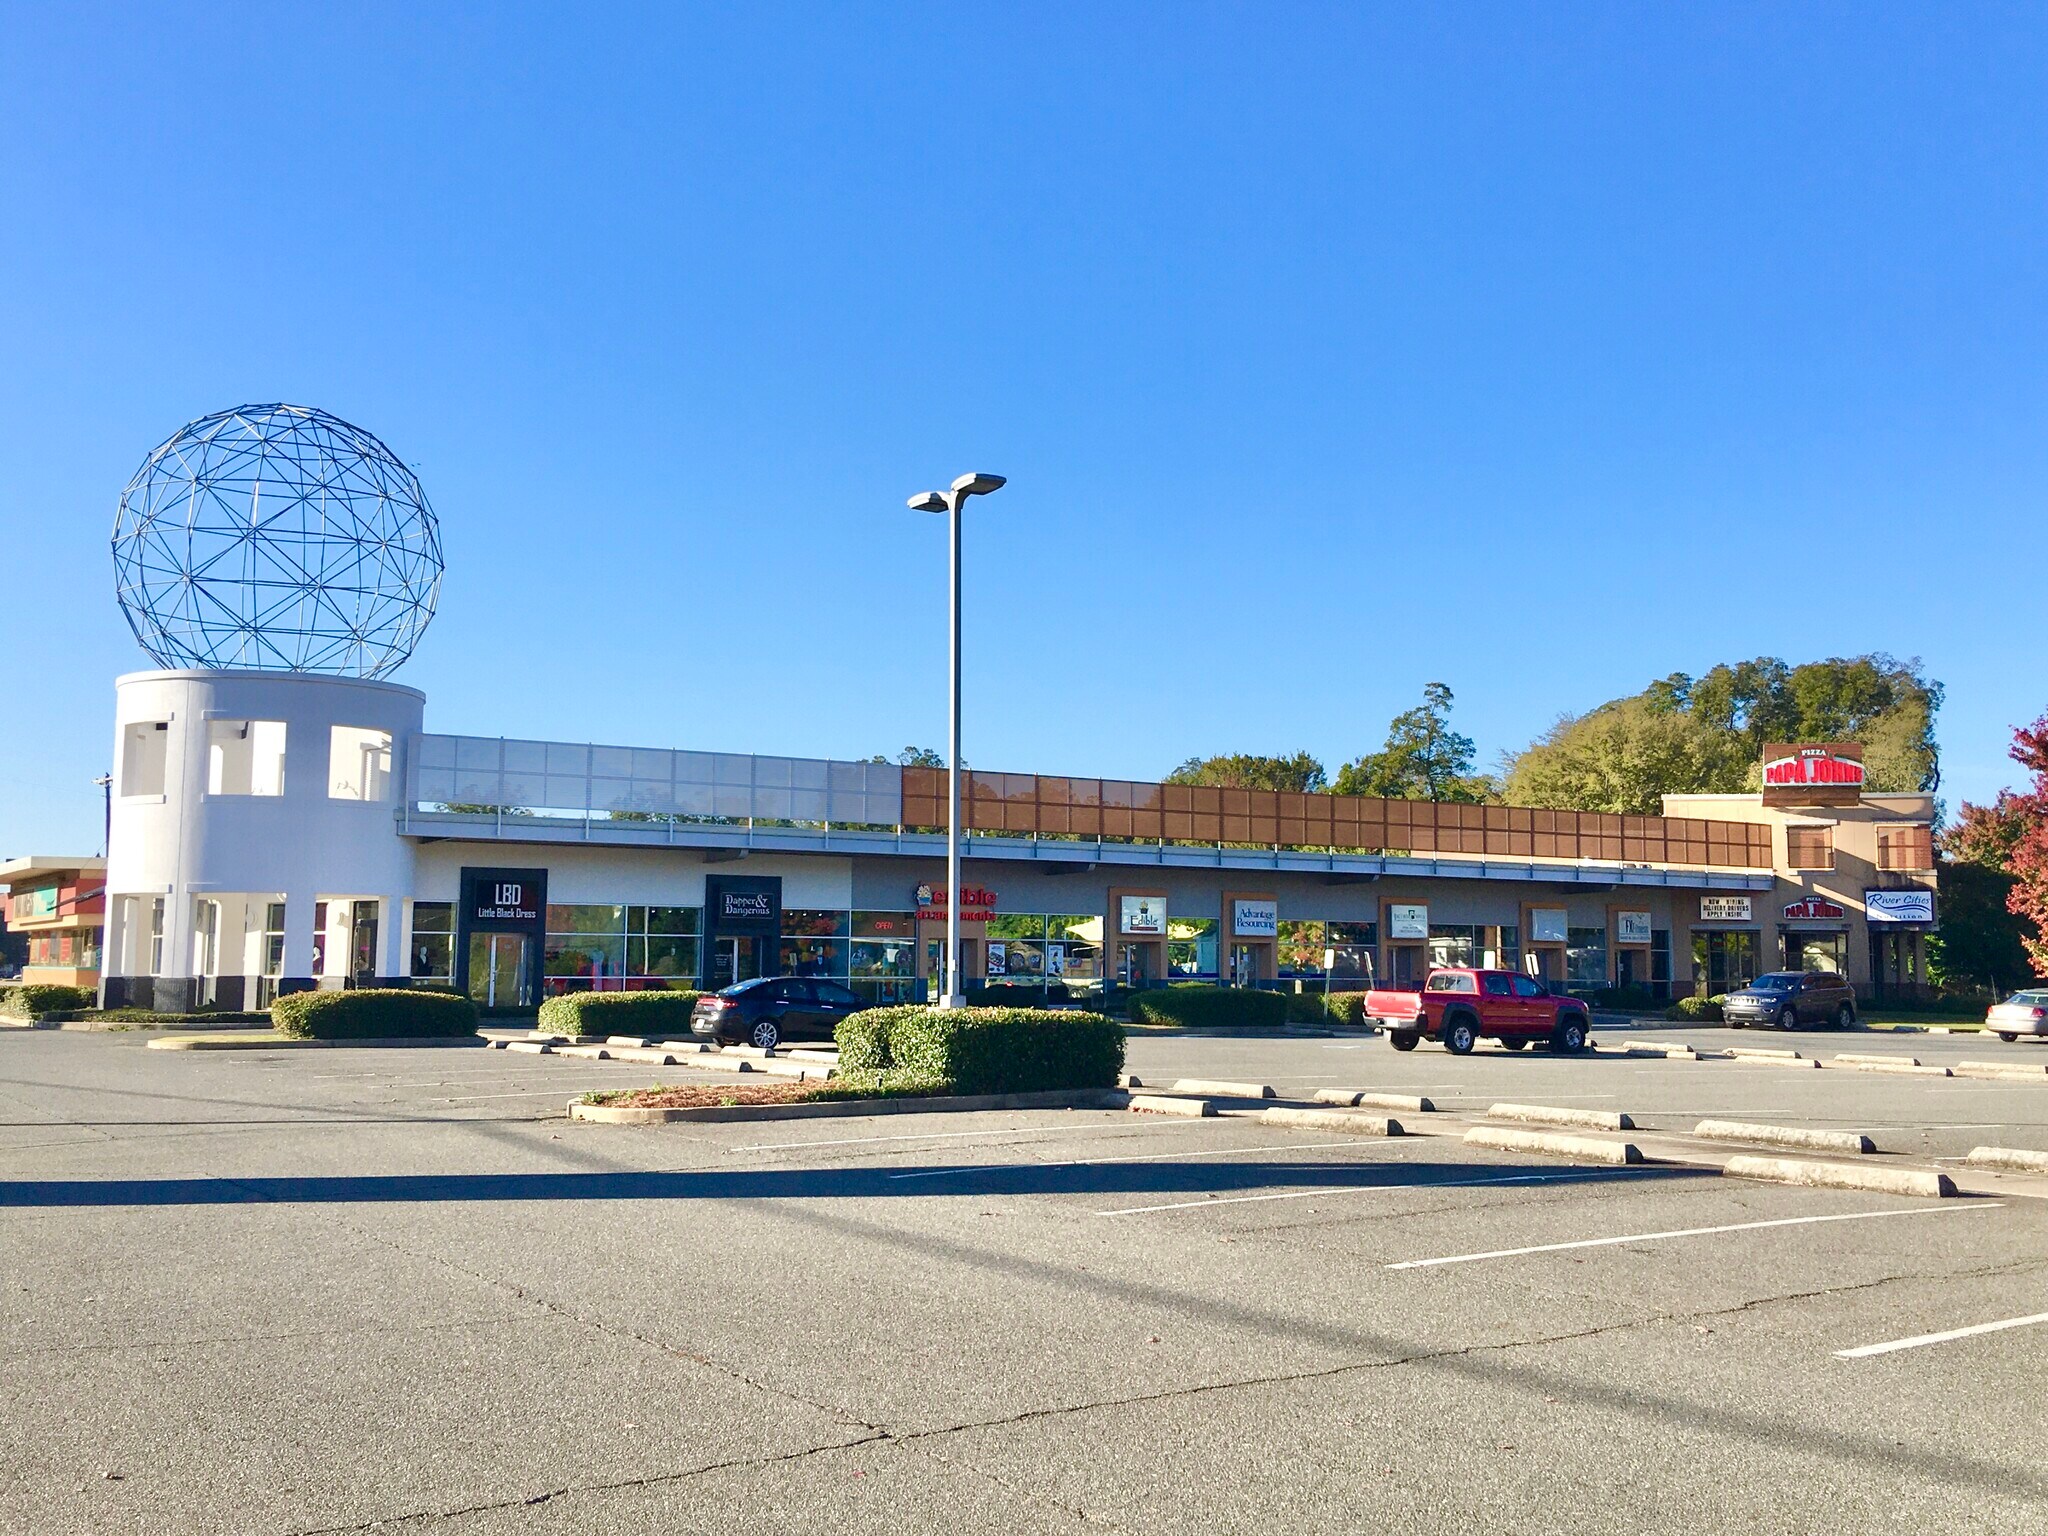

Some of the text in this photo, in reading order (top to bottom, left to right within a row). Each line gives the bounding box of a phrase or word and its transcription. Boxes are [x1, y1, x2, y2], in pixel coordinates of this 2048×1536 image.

[1766, 760, 1808, 783] PAPA
[495, 883, 522, 905] LBD
[932, 887, 997, 906] eible
[1867, 893, 1931, 906] River Cities
[725, 894, 769, 908] Dapper &
[478, 907, 537, 919] Little Black Dress
[725, 904, 770, 917] Dangerous
[1241, 908, 1276, 920] Advantage
[1785, 903, 1810, 918] PAPA
[875, 921, 894, 930] OPEN
[1131, 915, 1158, 926] Edible
[1237, 917, 1276, 930] Resourcing
